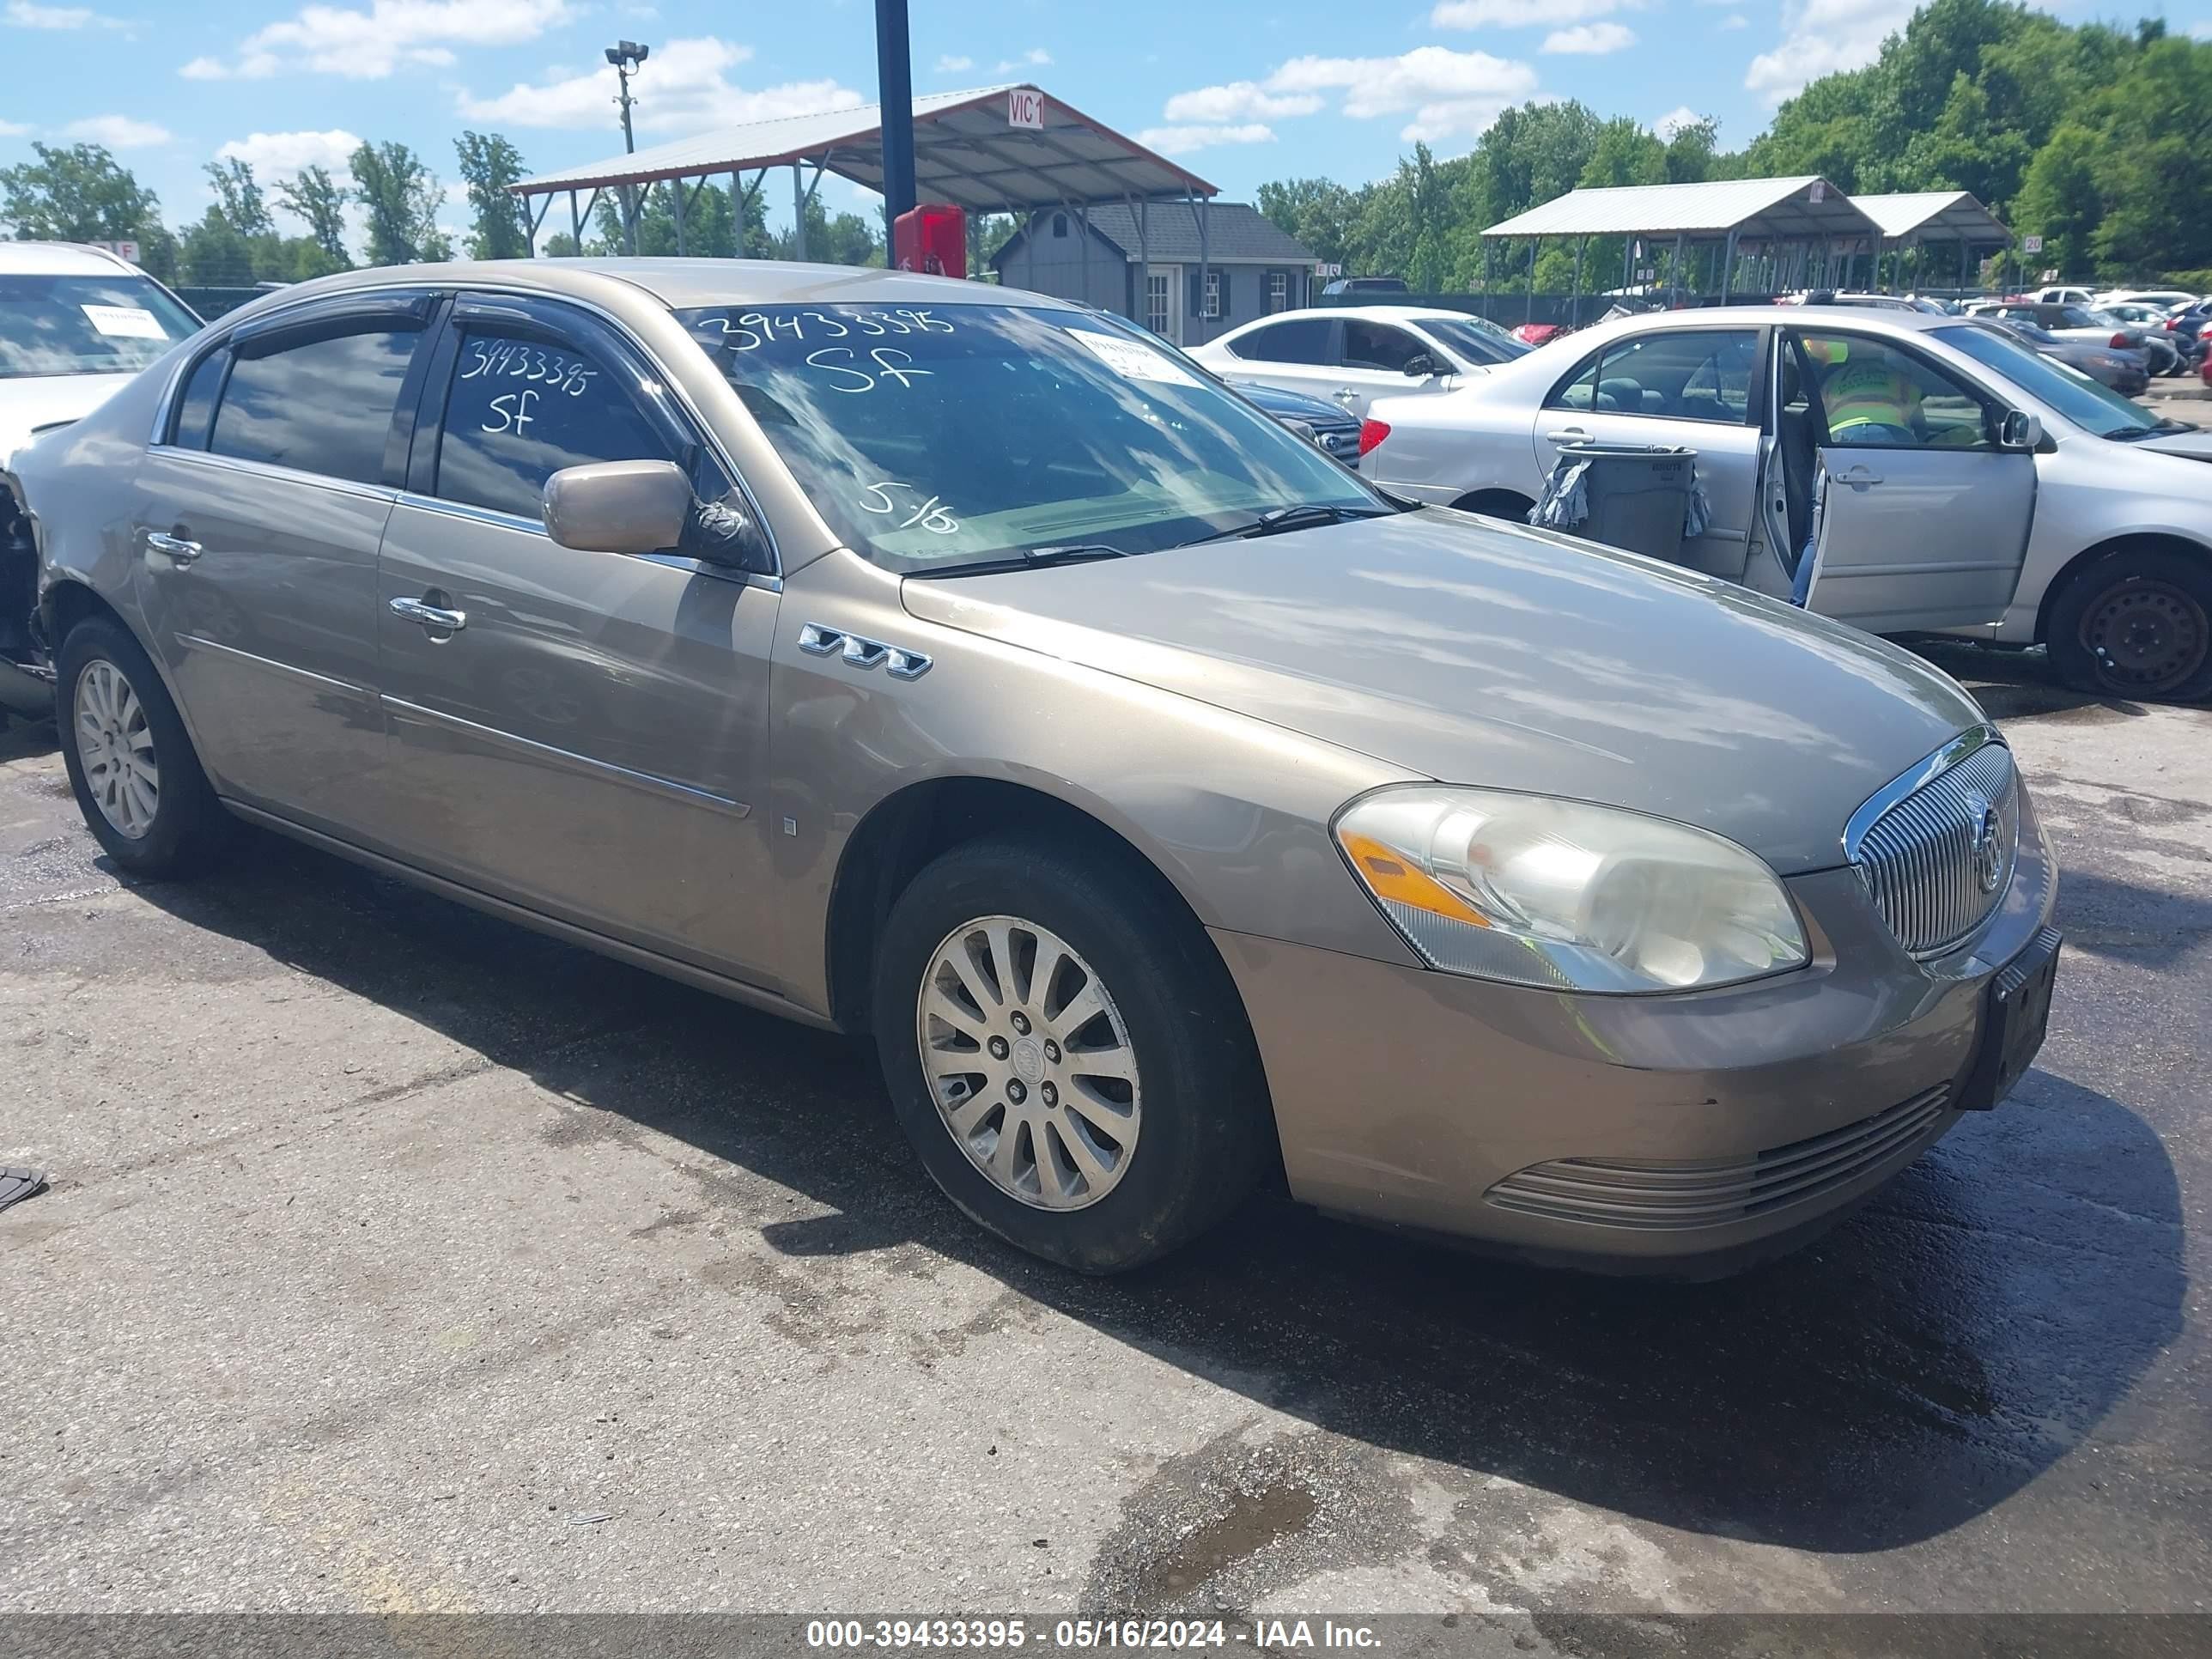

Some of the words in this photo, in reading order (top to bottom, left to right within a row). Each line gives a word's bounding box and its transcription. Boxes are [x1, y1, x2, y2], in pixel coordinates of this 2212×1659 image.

[1011, 94, 1033, 123] VIC
[1036, 96, 1042, 125] 1
[122, 245, 131, 258] F
[2027, 240, 2040, 249] 20
[697, 309, 954, 351] 39433395
[460, 338, 599, 397] 39433395
